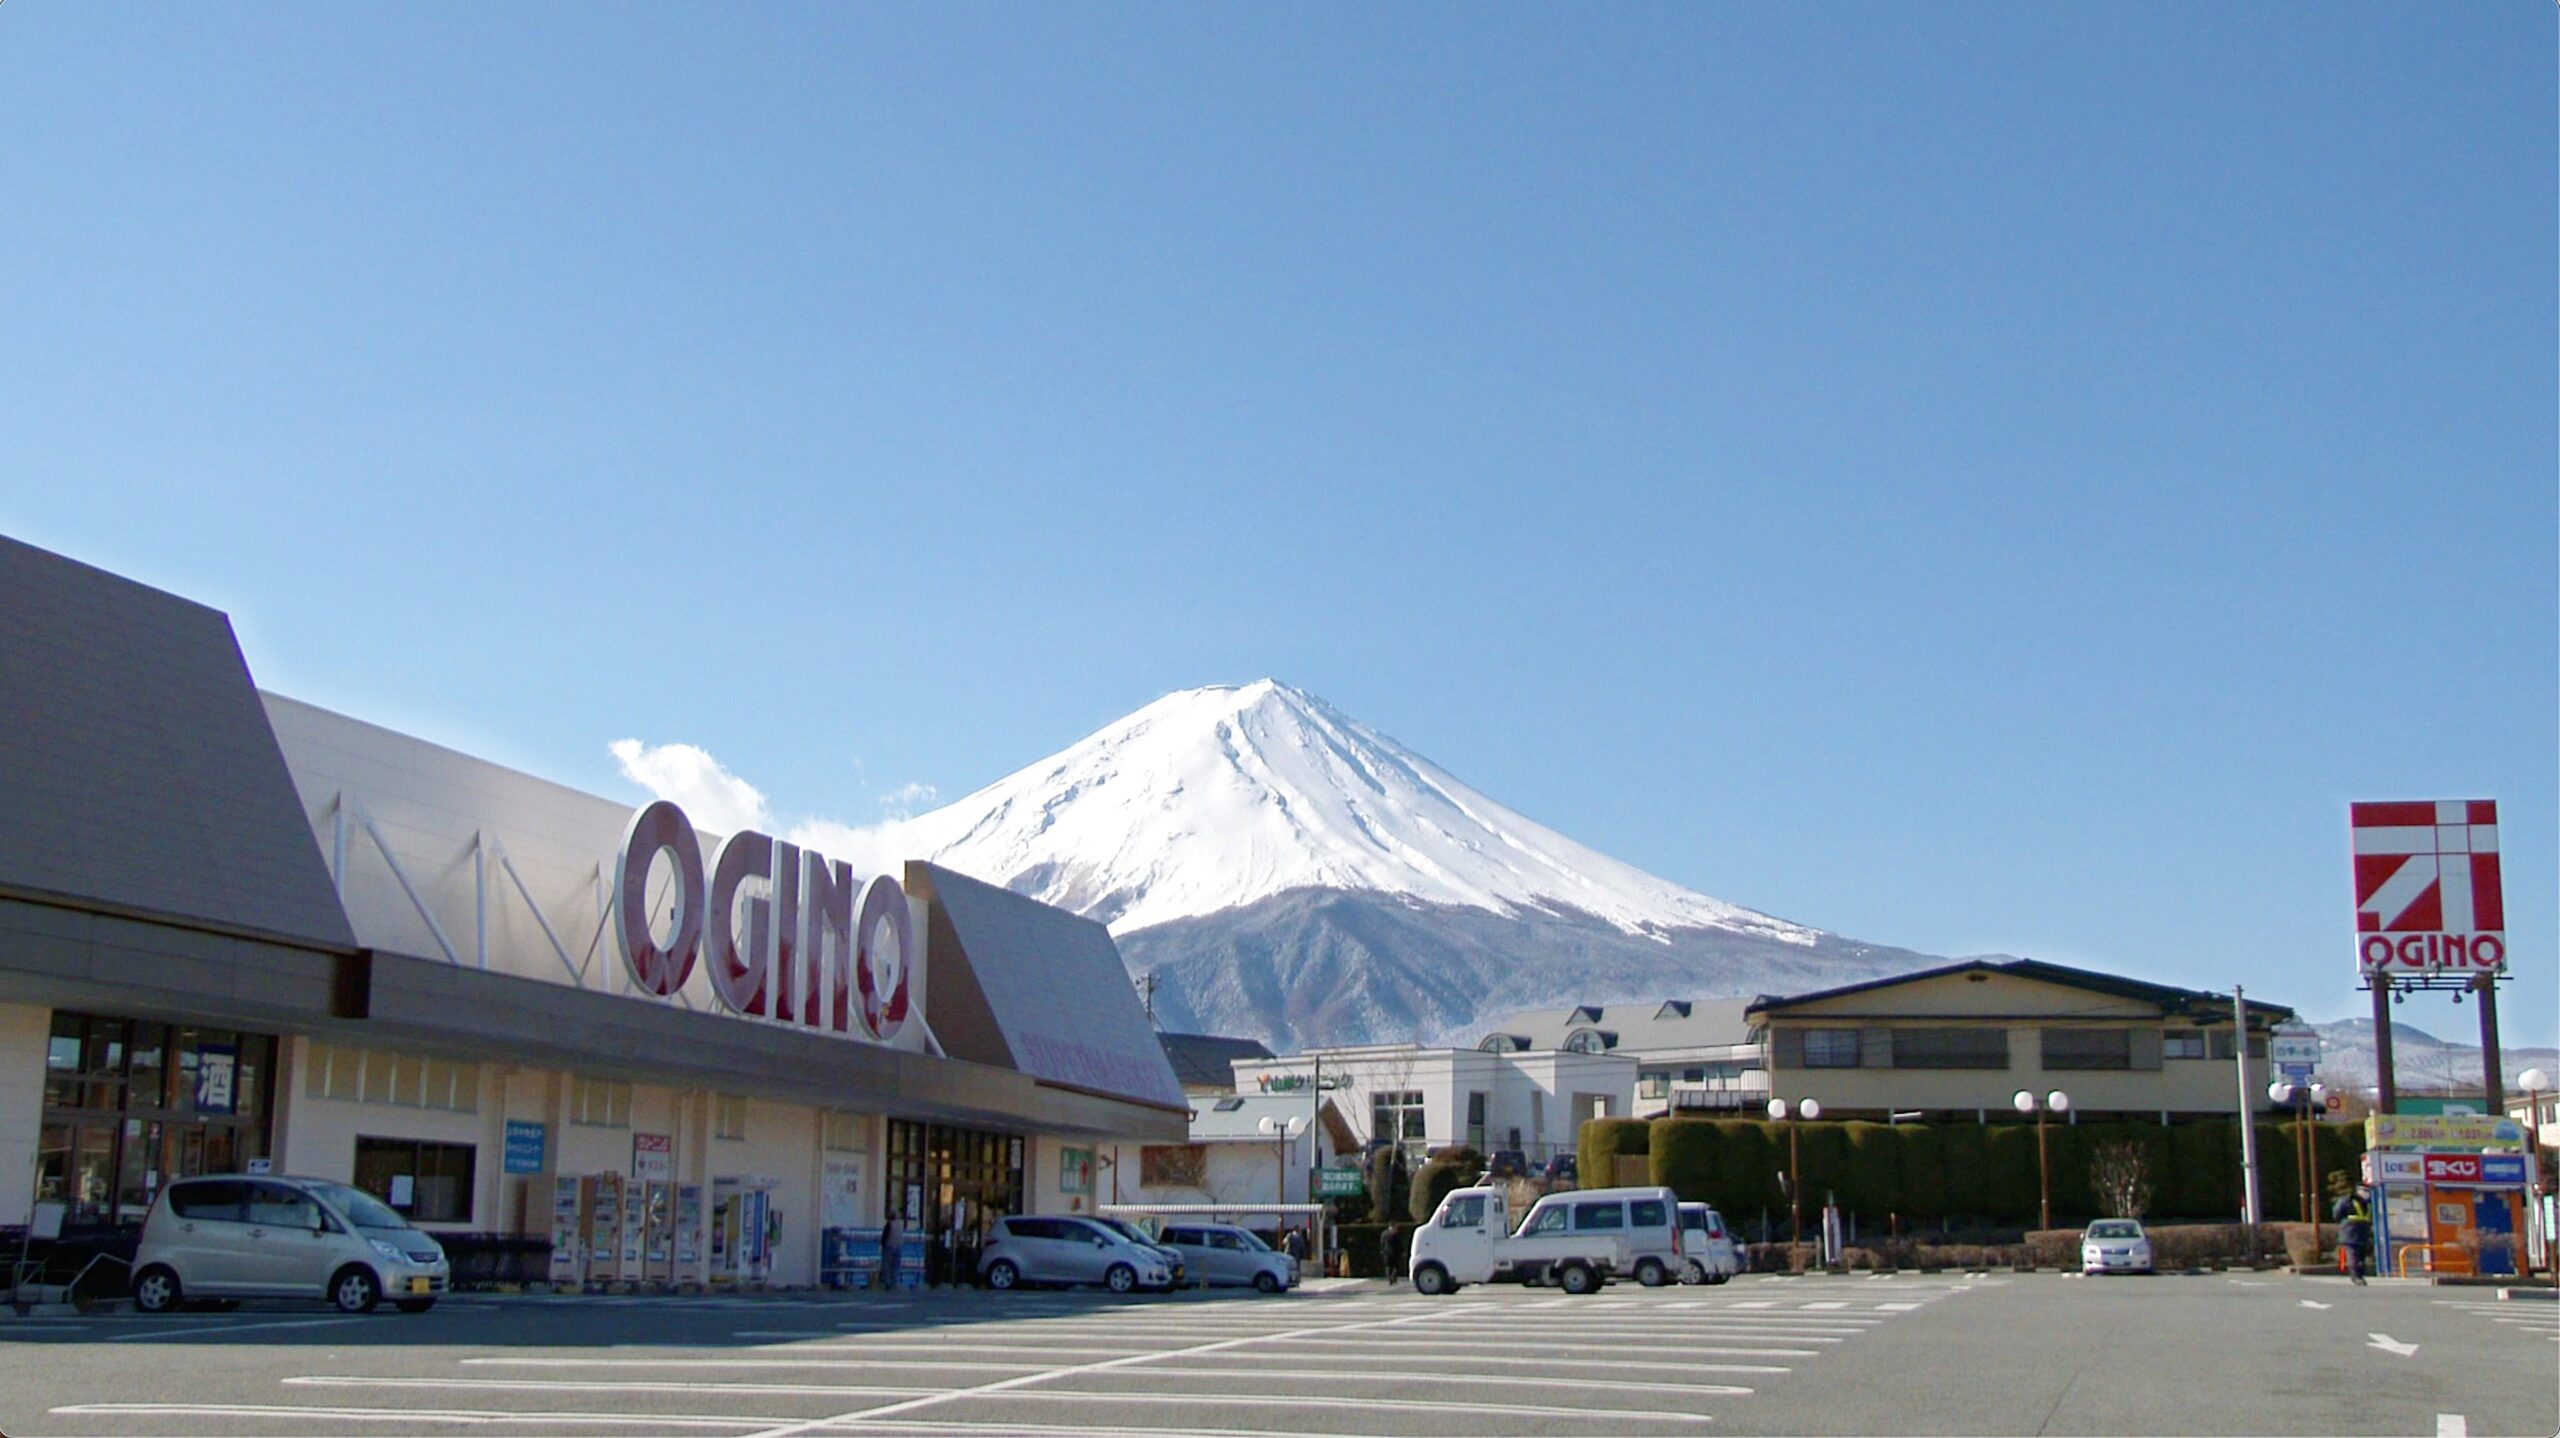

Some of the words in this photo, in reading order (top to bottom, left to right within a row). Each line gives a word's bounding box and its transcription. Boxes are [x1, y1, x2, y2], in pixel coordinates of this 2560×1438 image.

[613, 799, 913, 1040] OGINO
[2360, 934, 2504, 967] OGINO
[198, 1051, 235, 1106] 酒
[2427, 1160, 2476, 1176] 宝くじ
